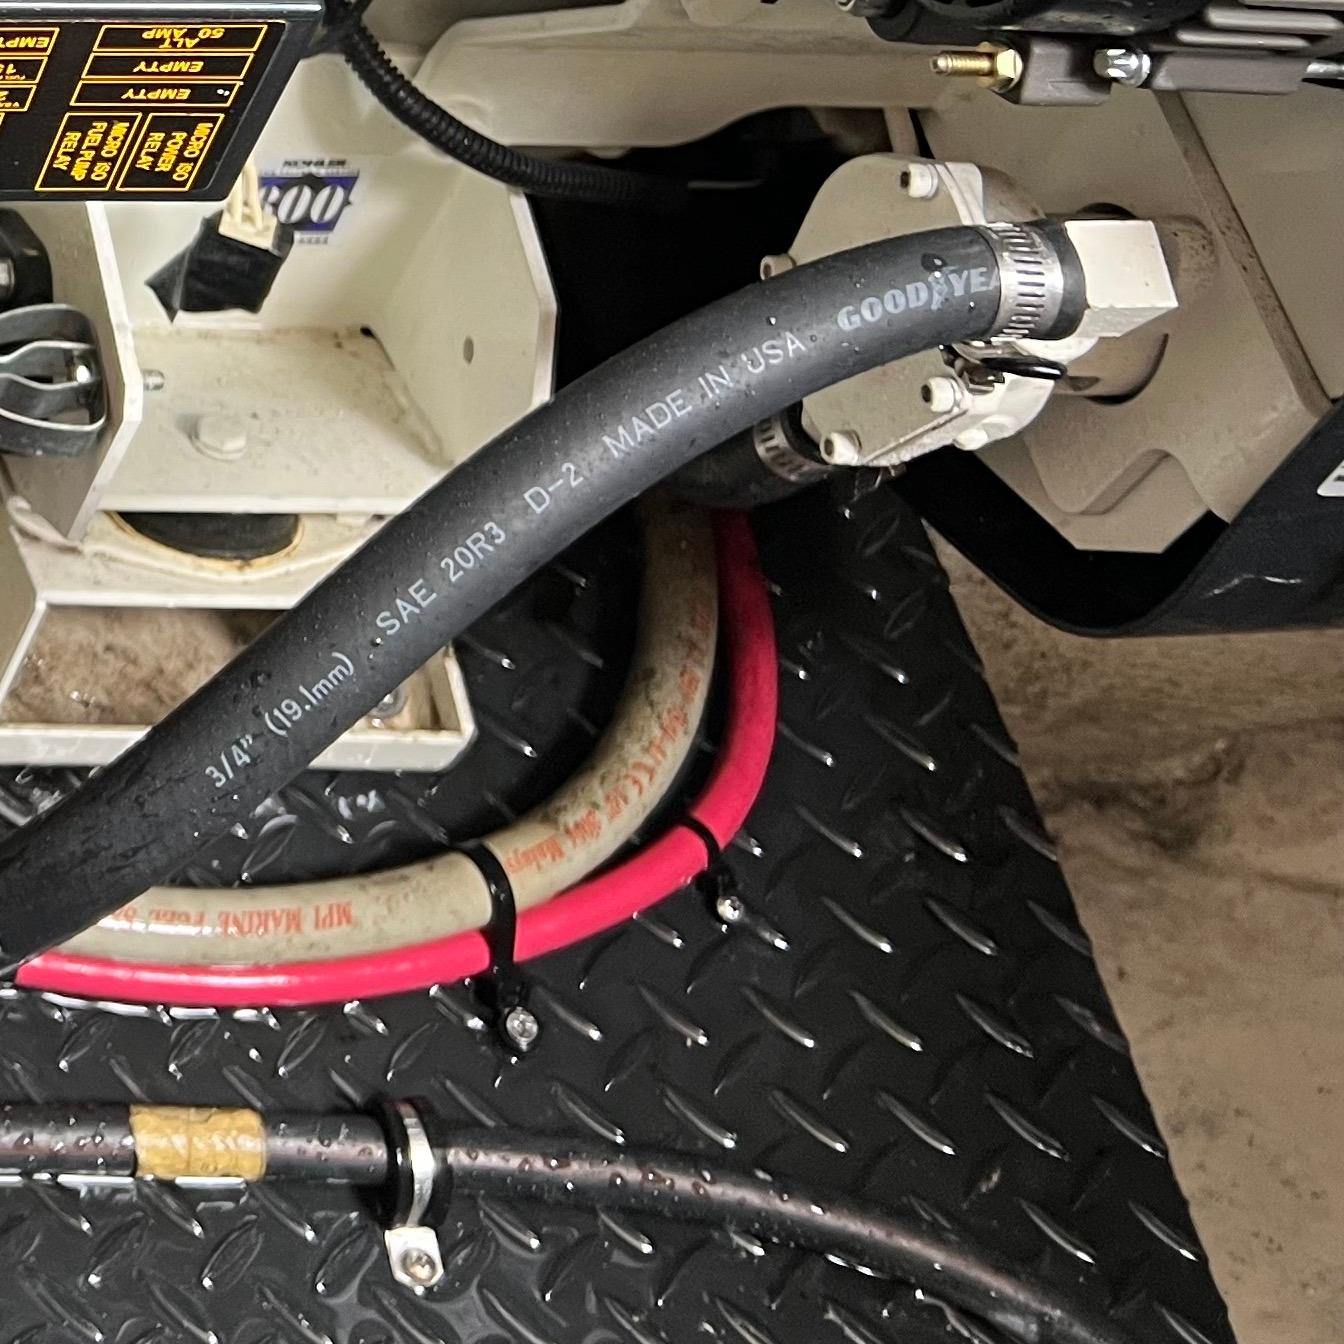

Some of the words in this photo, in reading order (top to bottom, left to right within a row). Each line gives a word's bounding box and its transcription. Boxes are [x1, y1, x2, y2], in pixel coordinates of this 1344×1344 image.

[141, 28, 189, 40] AMP
[158, 38, 201, 49] ALT
[197, 28, 226, 39] 50
[133, 60, 205, 73] EMPTY
[120, 88, 192, 100] EMPTY
[52, 131, 82, 171] RELAY
[101, 121, 130, 158] MICRO
[135, 132, 166, 171] RELAY
[264, 651, 355, 737] (19.1mm)
[375, 579, 438, 636] SAE
[440, 521, 507, 583] 20R3
[522, 461, 584, 515] D-2
[601, 388, 694, 459] MADE
[698, 365, 735, 400] IN
[743, 331, 809, 375] USA
[836, 265, 1001, 332] GOODYE
[217, 905, 304, 938] MARINE
[315, 900, 354, 930] MPI
